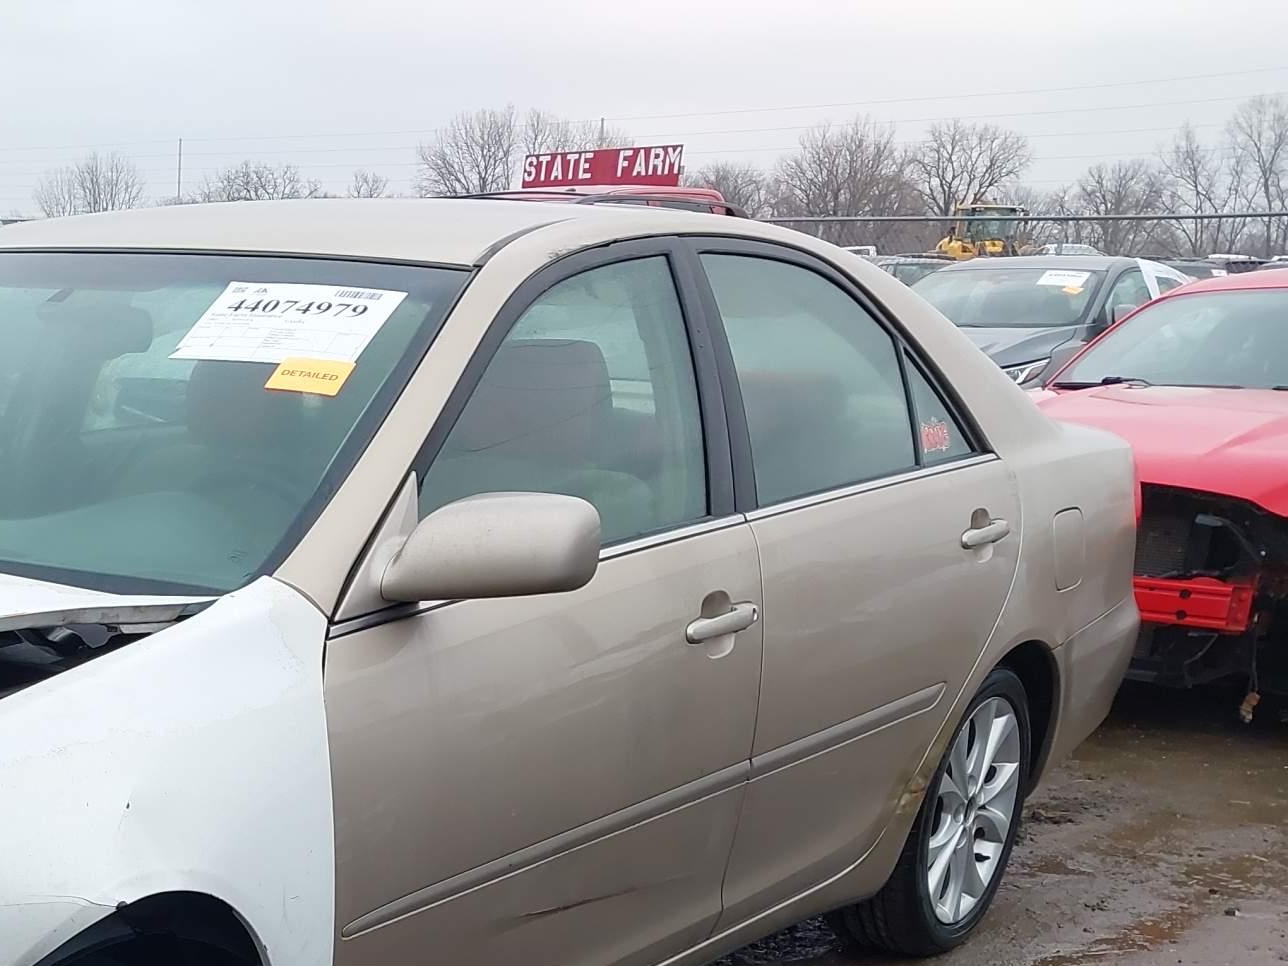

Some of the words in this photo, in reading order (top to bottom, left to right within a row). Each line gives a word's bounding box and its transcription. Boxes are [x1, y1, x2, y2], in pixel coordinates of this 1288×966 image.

[524, 152, 594, 182] STATE
[616, 146, 682, 178] FARM
[227, 298, 368, 318] 44074979
[281, 369, 339, 382] DETAILED
